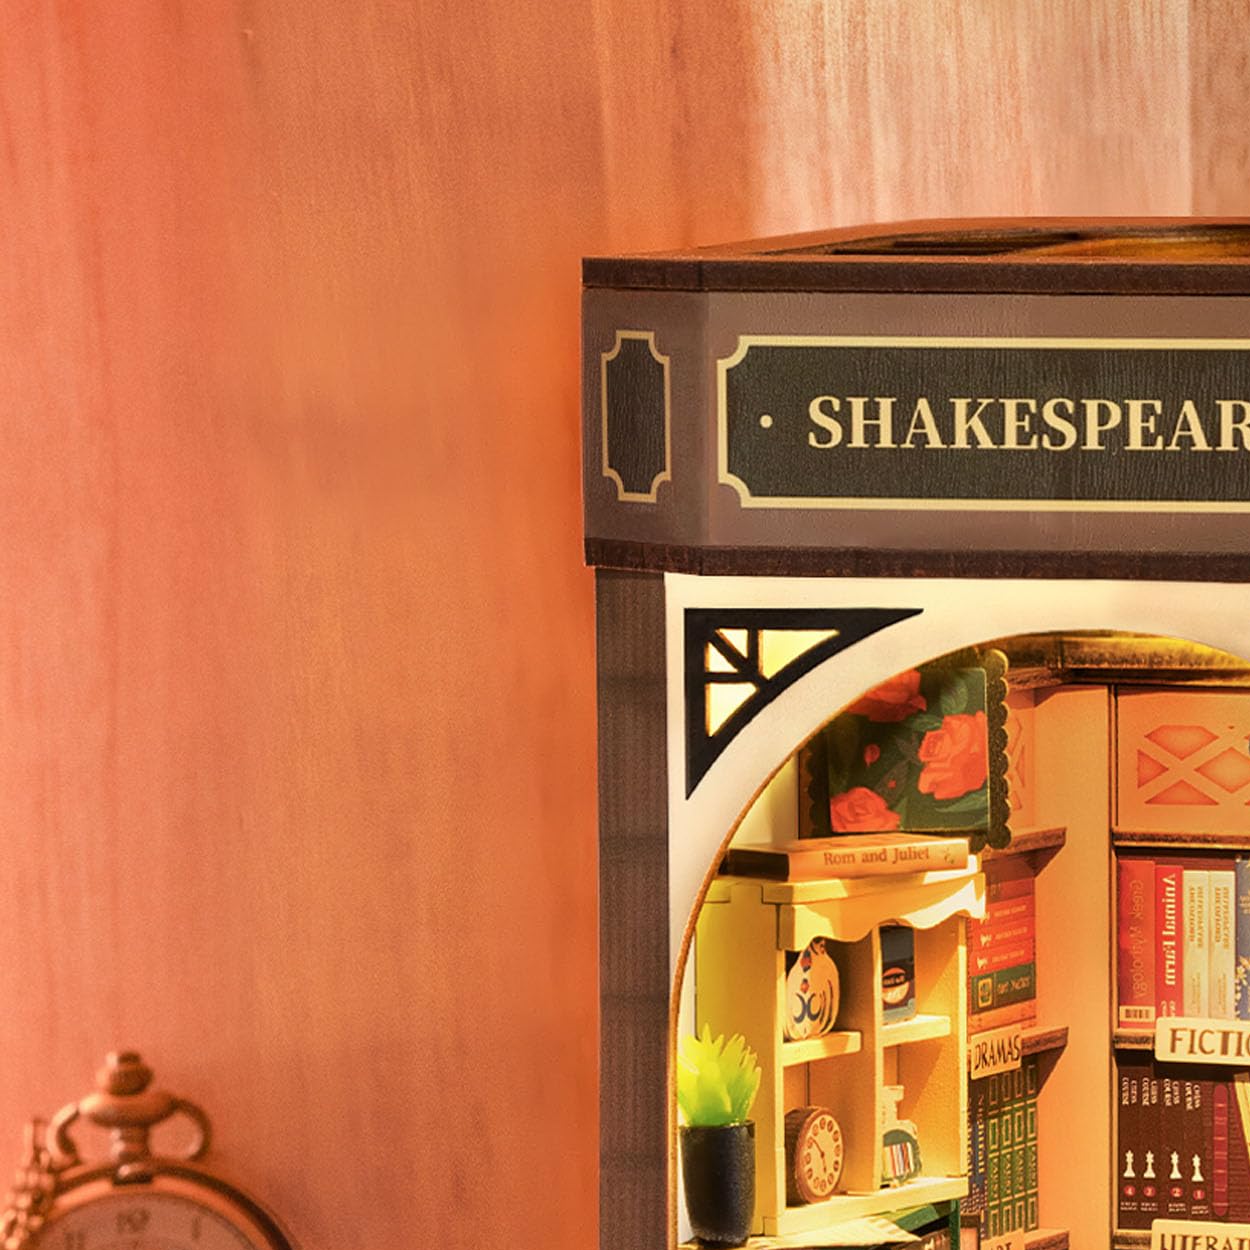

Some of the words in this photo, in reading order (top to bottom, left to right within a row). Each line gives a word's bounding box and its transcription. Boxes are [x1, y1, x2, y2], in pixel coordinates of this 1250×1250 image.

[824, 851, 856, 866] Rom
[861, 849, 887, 863] and
[892, 847, 930, 864] Juliet
[974, 1034, 1021, 1071] DRAMAS
